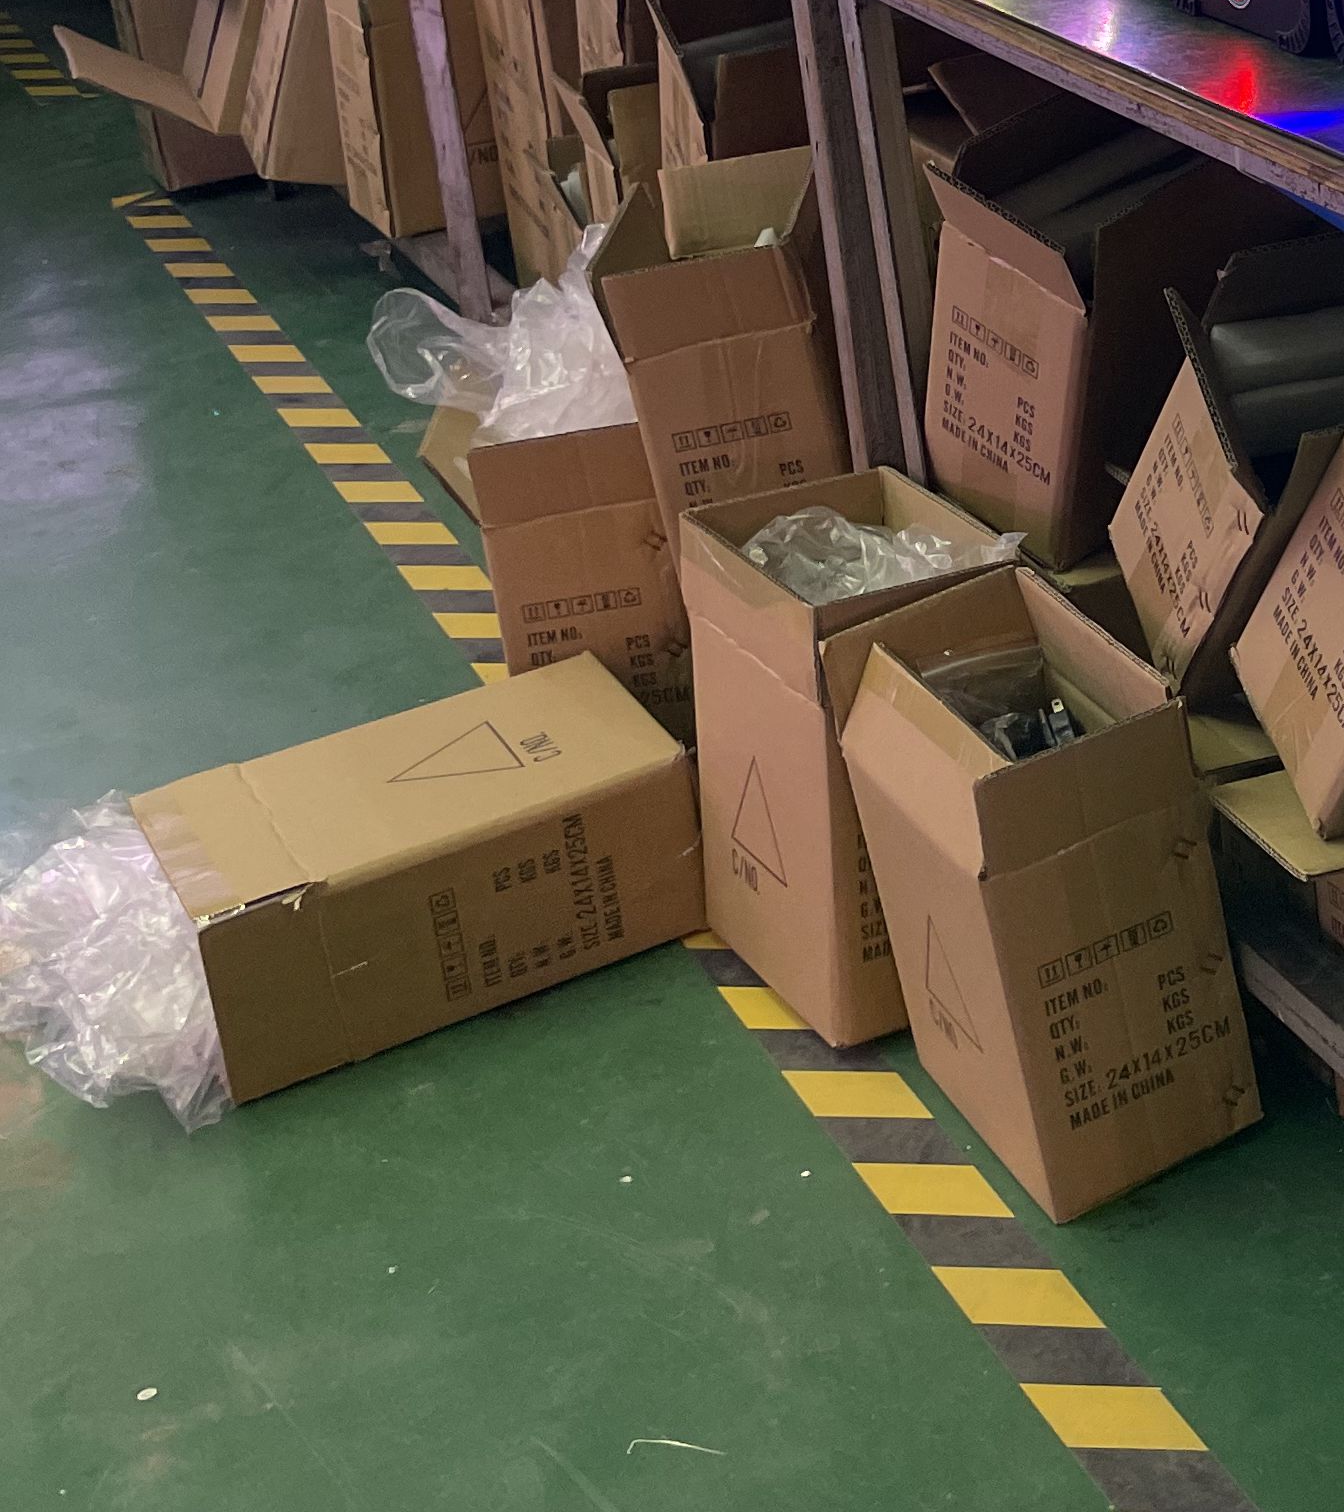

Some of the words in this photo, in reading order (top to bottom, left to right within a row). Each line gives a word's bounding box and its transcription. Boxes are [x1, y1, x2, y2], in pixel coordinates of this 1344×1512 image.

[949, 331, 971, 356] ITEM
[1017, 396, 1036, 419] PCS
[1015, 413, 1034, 436] KGS
[942, 416, 967, 444] MADE
[968, 435, 979, 452] IN
[980, 445, 1010, 474] CHINA
[967, 416, 1051, 486] 24X14X25CM
[1013, 431, 1032, 453] KGS
[679, 458, 710, 477] ITEM
[779, 459, 805, 477] PCS
[1319, 515, 1337, 551] ITEM
[1187, 539, 1198, 570] PCS
[1151, 551, 1166, 594] CHINA
[528, 629, 558, 648] ITEM
[625, 634, 651, 651] PCS
[630, 653, 655, 668] KGS
[1273, 604, 1293, 645] MADE
[1289, 639, 1301, 660] IN
[1296, 655, 1318, 701] CHINA
[596, 855, 617, 893] CHINA
[861, 919, 888, 937] SIZ
[863, 939, 892, 964] MAD
[1157, 966, 1186, 991] PCS
[1045, 988, 1080, 1017] ITEM
[1162, 988, 1190, 1013] KGS
[1166, 1010, 1195, 1035] KGS
[1104, 1015, 1232, 1090] 24X14X25CM
[1069, 1096, 1111, 1131] MADE
[1112, 1089, 1129, 1110] IN
[1131, 1068, 1176, 1101] CHINA
